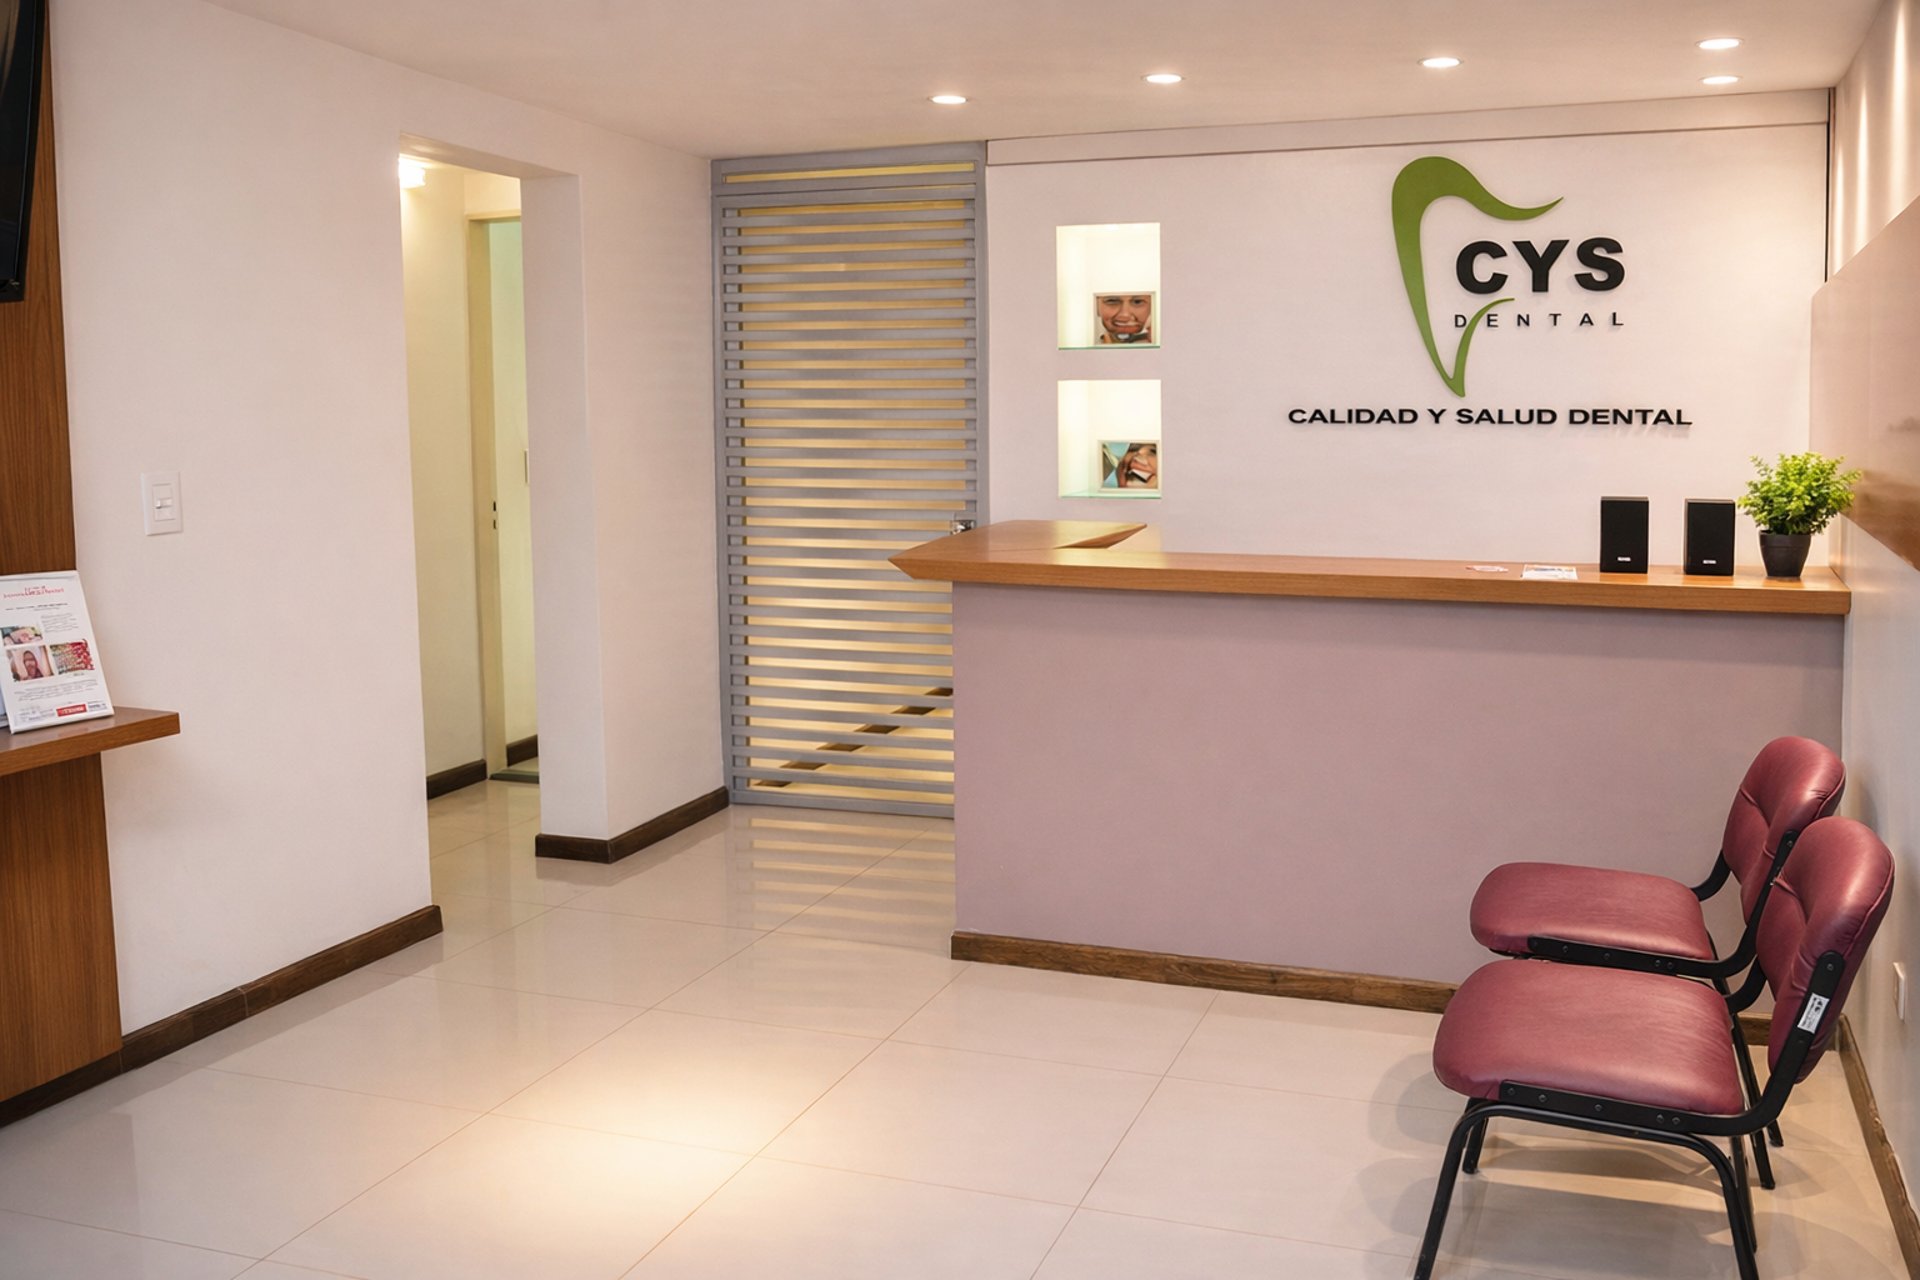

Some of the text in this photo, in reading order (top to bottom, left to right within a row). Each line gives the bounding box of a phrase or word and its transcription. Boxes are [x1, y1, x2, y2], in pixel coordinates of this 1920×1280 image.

[1456, 237, 1626, 295] CYS
[1454, 312, 1625, 328] DENTAL
[1288, 408, 1693, 426] CALIDAD Y SALUD DENTAL
